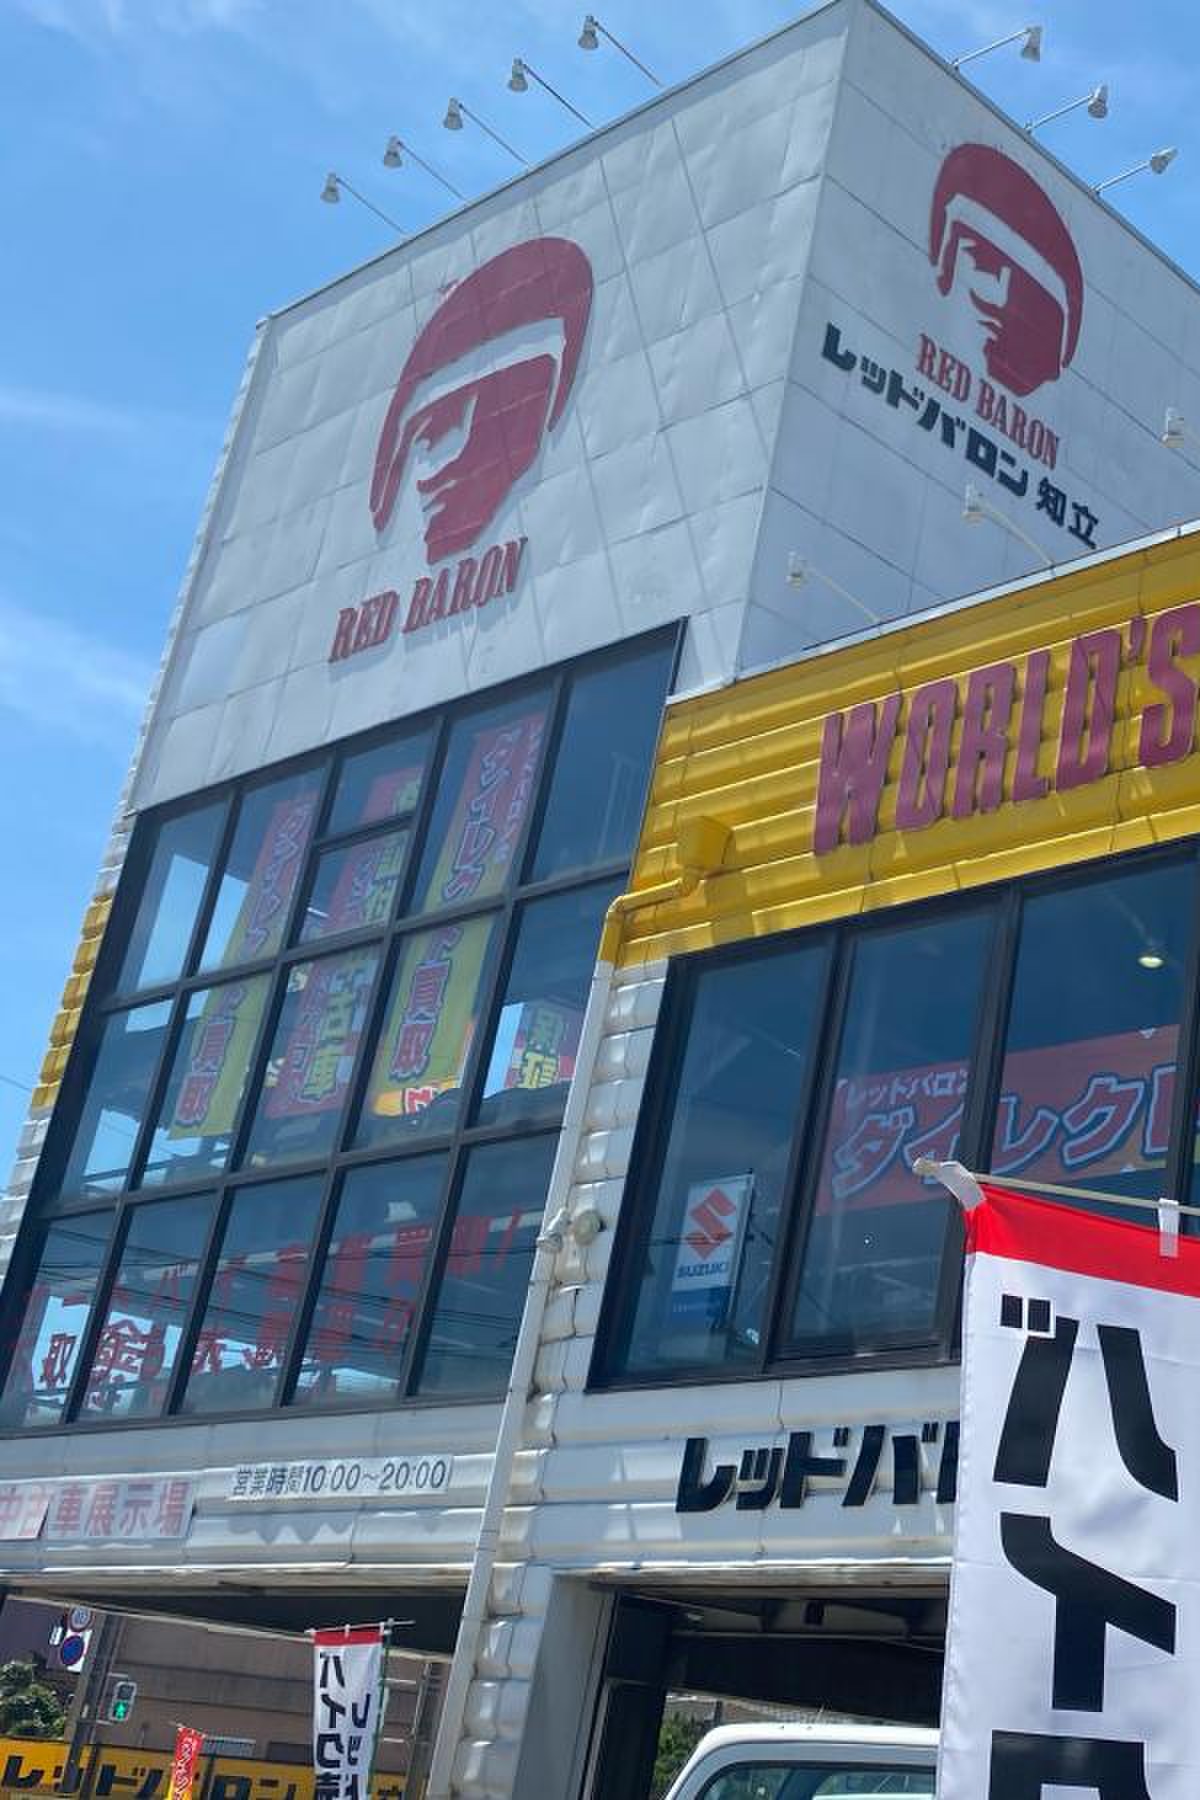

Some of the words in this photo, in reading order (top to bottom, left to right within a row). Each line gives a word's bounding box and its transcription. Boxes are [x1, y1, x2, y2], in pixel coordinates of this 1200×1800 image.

[821, 321, 1029, 497] レッドバロン
[1035, 476, 1099, 550] 知立
[916, 332, 972, 403] RED
[975, 378, 1060, 471] BARON
[328, 589, 400, 663] RED
[401, 536, 528, 634] BARON
[675, 1262, 728, 1279] SUZUKI
